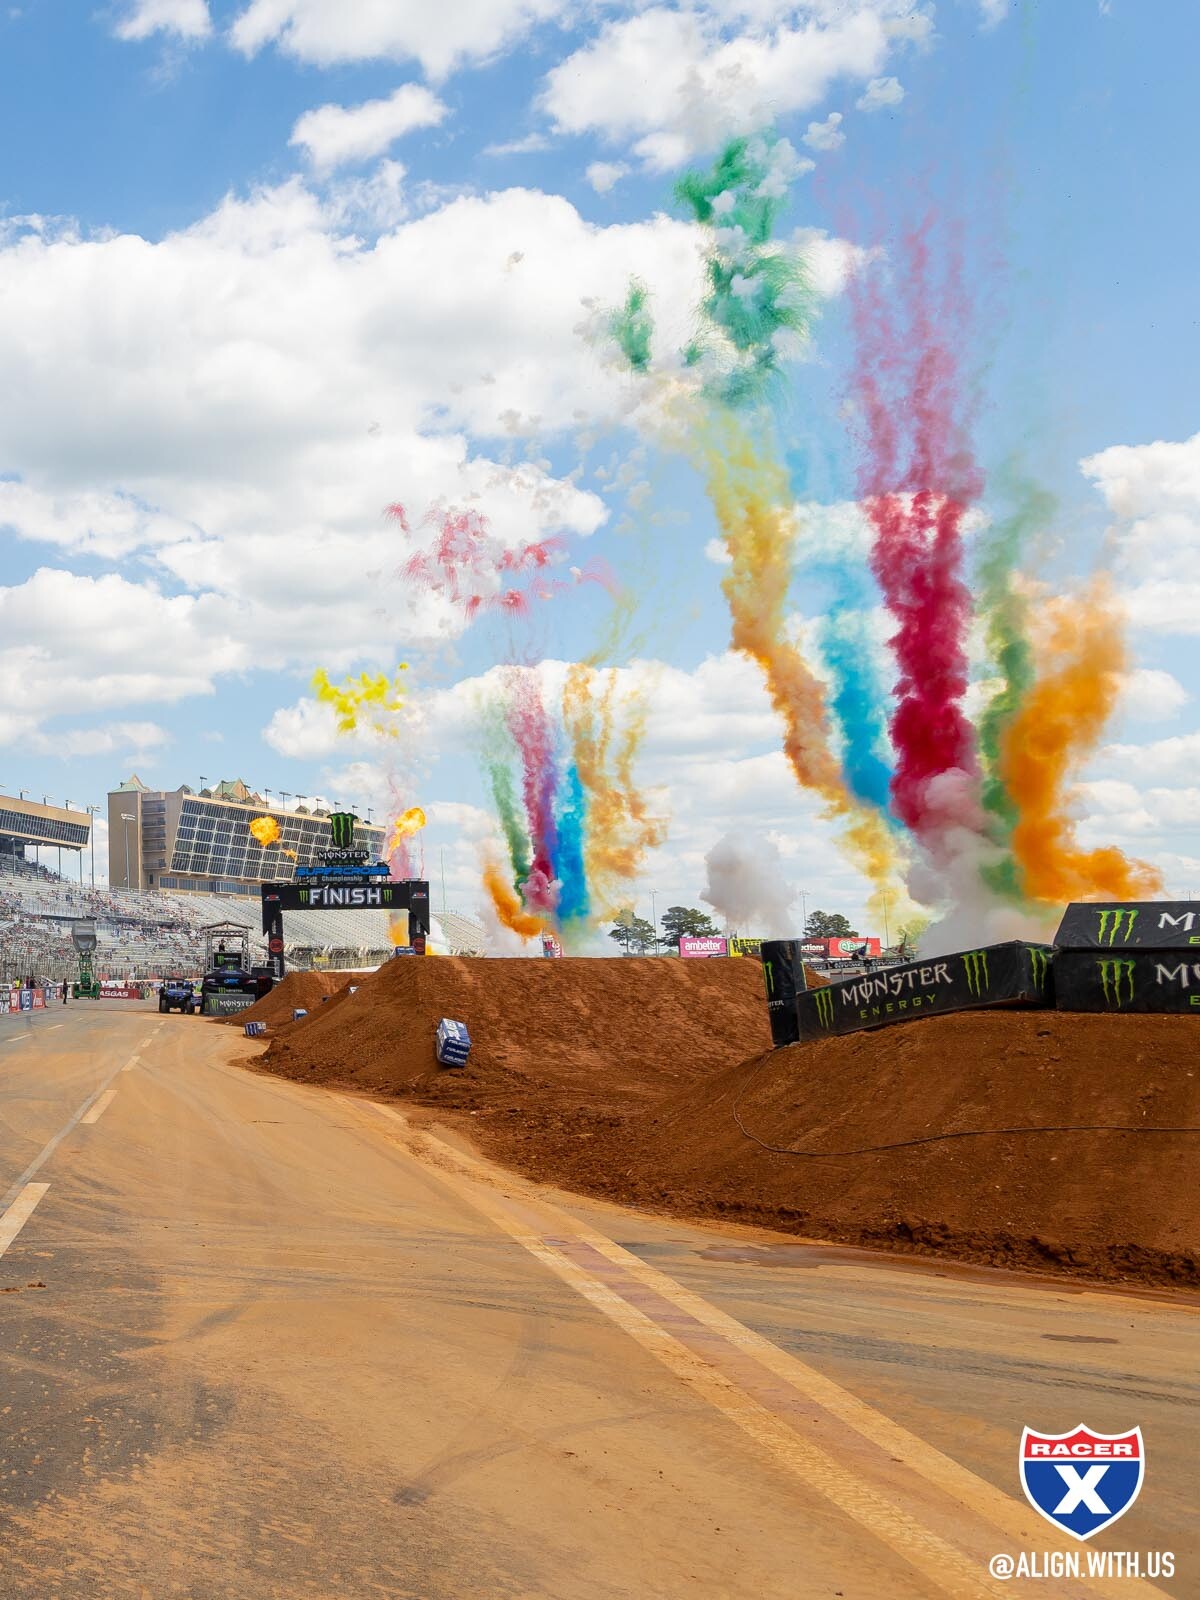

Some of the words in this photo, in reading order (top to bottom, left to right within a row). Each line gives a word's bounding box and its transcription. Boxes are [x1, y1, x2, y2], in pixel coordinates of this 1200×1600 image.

[318, 851, 368, 860] MONSTER
[296, 867, 389, 876] SUPERCROSS
[309, 888, 382, 905] FINISH
[685, 941, 721, 950] ambetter
[841, 962, 953, 1007] MONSTER
[100, 990, 128, 998] ASGAS
[859, 993, 936, 1019] ENERGY
